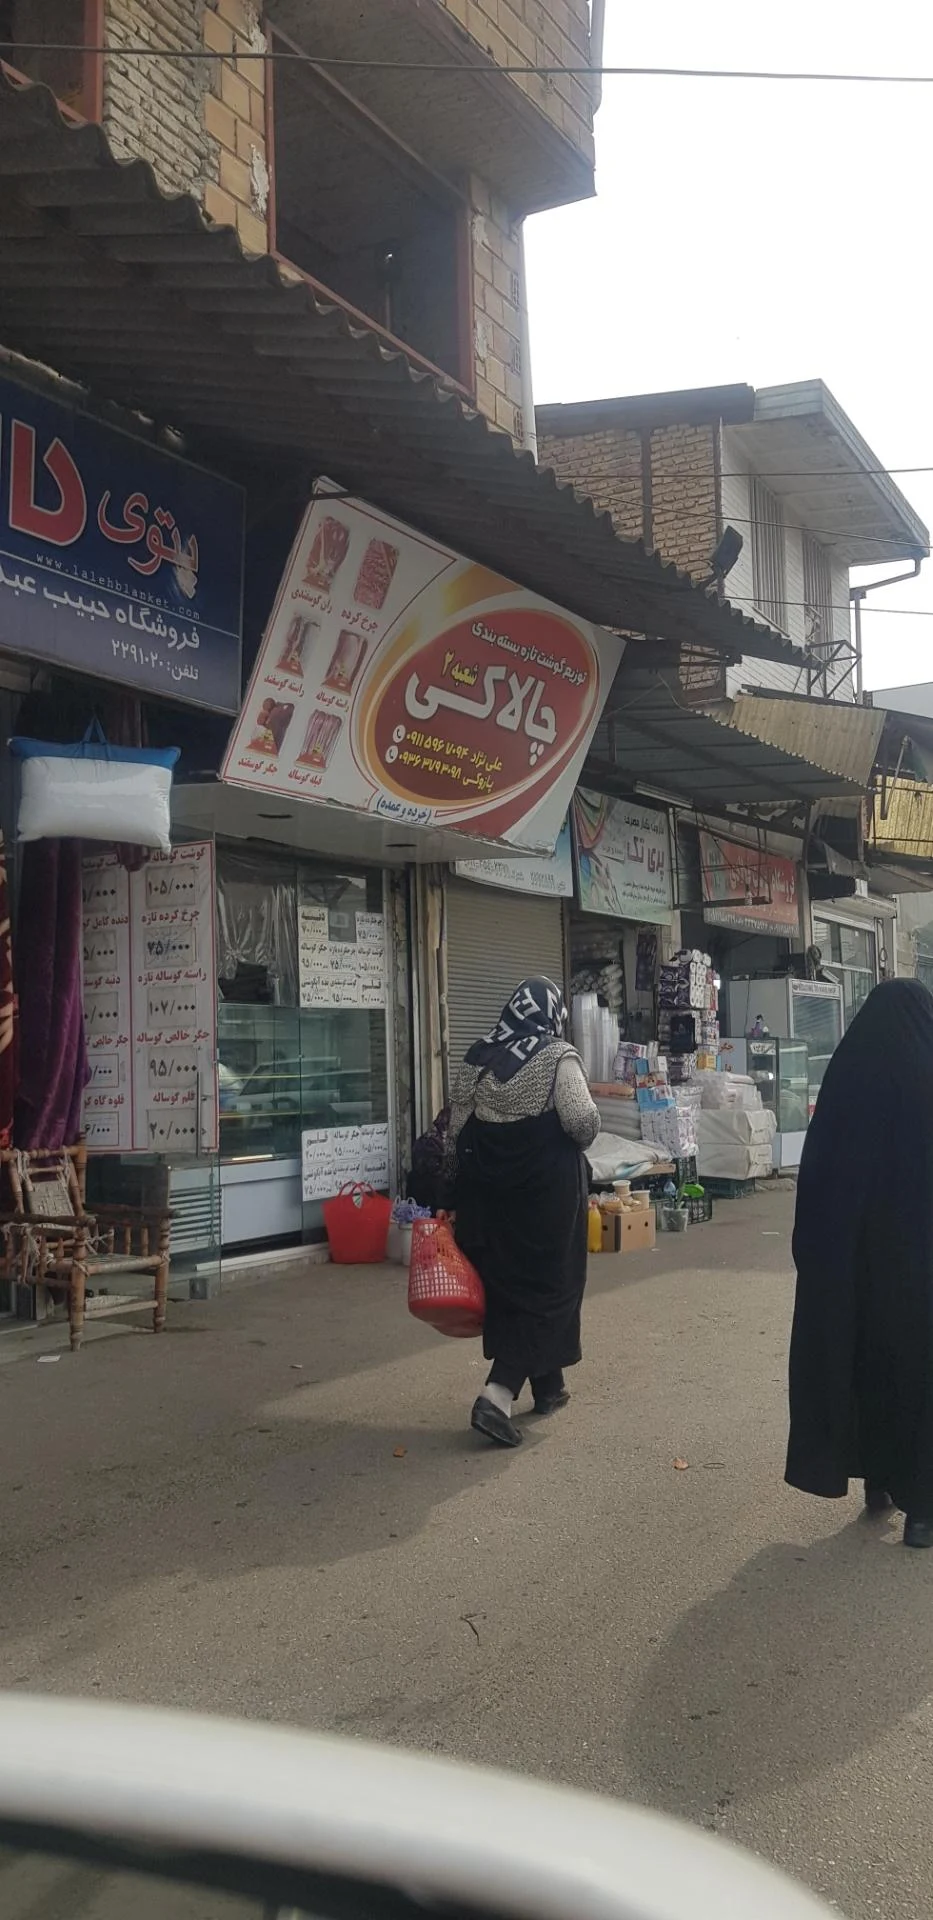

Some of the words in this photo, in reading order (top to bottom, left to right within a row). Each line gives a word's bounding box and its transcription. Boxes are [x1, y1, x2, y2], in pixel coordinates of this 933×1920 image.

[0, 410, 86, 547] لا
[0, 564, 36, 596] عبد
[36, 551, 200, 621] www.lalehblanket.com
[44, 587, 110, 619] حبیب
[291, 589, 321, 609] گوسفندی
[320, 598, 333, 614] ران
[116, 607, 200, 650] فروشگاه
[361, 616, 378, 634] چرخ
[472, 622, 497, 647] بندی
[497, 635, 520, 657] بسته
[521, 645, 538, 662] تازه
[441, 651, 454, 677] ۲
[538, 652, 566, 676] گوشت
[451, 664, 479, 687] شعبه
[563, 668, 588, 687] توزیع
[287, 682, 304, 698] راسته
[316, 690, 336, 707] گوساله
[405, 665, 558, 767] چالاکی
[406, 730, 425, 748] ۰۹۱۱
[423, 737, 445, 752] ۵۹۶
[399, 751, 421, 767] ۰۹۳۶
[445, 743, 469, 760] ۷۰۹۴
[470, 751, 487, 768] نژاد
[238, 757, 264, 773] گوسفند
[263, 762, 278, 775] جگر
[485, 756, 503, 773] علی
[288, 768, 310, 785] گوساله
[181, 847, 206, 861] گوشت
[148, 878, 194, 896] ۱۰۵/۰۰۰
[92, 916, 109, 930] کامل
[111, 915, 129, 925] دنده
[141, 911, 158, 926] تازه
[159, 909, 180, 923] کرده
[182, 910, 200, 926] چرخ
[83, 945, 115, 961] ۵/۰۰۰
[147, 939, 190, 956] ۷۵/۰۰۰
[84, 976, 103, 989] گوسف
[105, 975, 121, 986] دنبه
[137, 972, 154, 986] تازه
[155, 970, 182, 984] گوساله
[183, 967, 207, 982] راسته
[84, 1005, 118, 1023] ۰/۰۰۰
[149, 1000, 196, 1016] ۱۰۷/۰۰۰
[92, 1035, 113, 1048] خالص
[115, 1034, 129, 1047] جگر
[136, 1032, 163, 1045] گوساله
[165, 1030, 190, 1045] خالص
[193, 1030, 210, 1043] جگر
[92, 1065, 113, 1080] /۰۰۰
[150, 1059, 197, 1077] ۹۵/۰۰۰
[153, 1092, 181, 1105] گوساله
[181, 1091, 196, 1105] قلم
[84, 1123, 111, 1136] ۶/۰۰۰
[149, 1121, 196, 1140] ۲۰/۰۰۰
